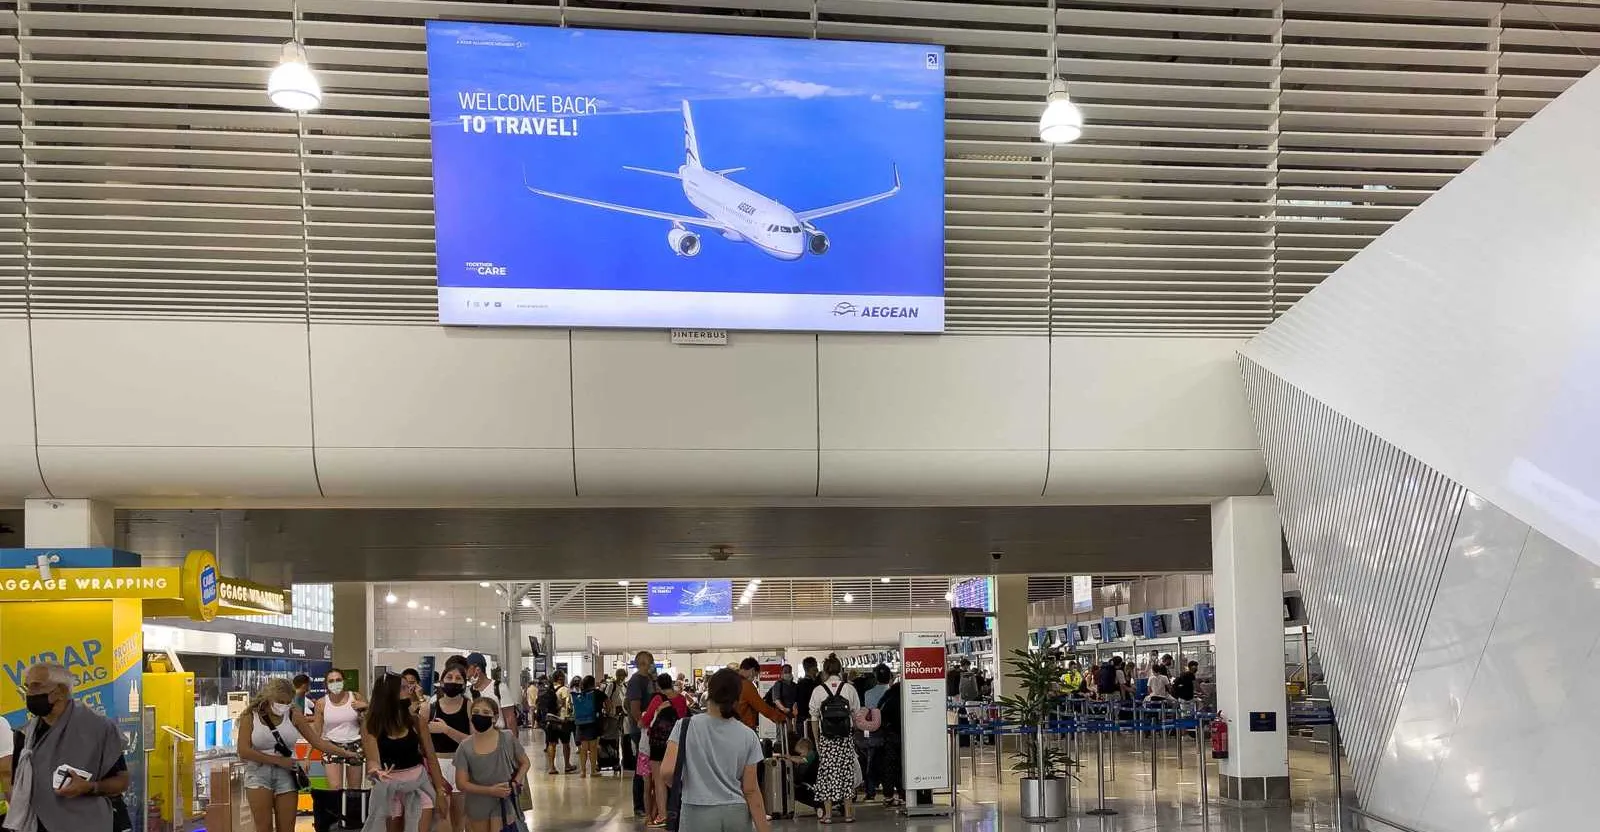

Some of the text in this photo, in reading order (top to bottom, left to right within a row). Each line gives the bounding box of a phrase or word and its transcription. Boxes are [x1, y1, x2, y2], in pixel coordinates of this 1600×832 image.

[458, 91, 597, 115] WELCOME BACK
[459, 114, 579, 137] TO TRAVEL!
[477, 266, 507, 276] CARE
[860, 306, 919, 319] AEGEAN
[75, 577, 168, 590] WRAPPING
[905, 667, 943, 675] PRIORITY
